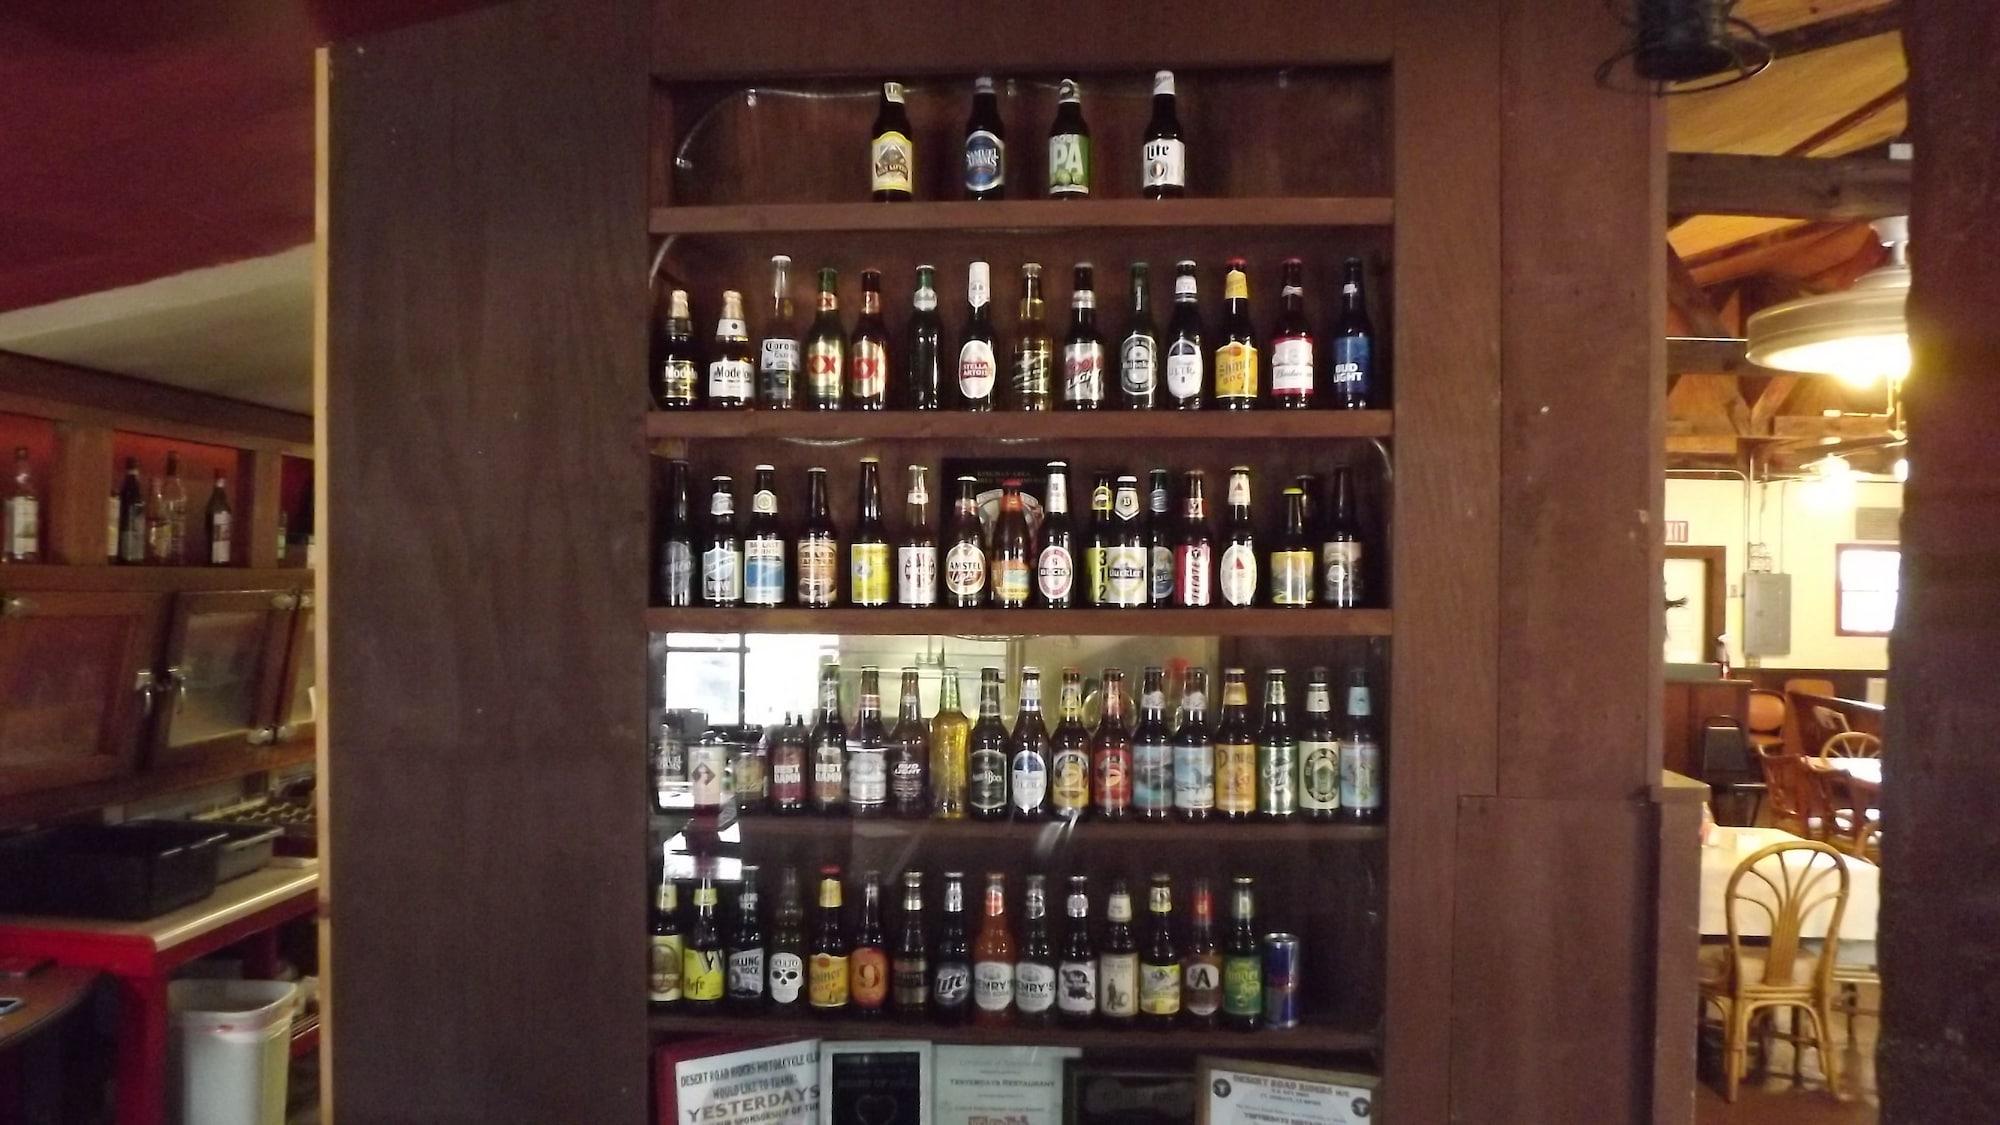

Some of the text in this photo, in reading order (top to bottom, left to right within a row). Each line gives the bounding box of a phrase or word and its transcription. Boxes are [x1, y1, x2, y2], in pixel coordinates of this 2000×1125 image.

[1146, 143, 1170, 161] Lite
[1335, 363, 1358, 373] BUD
[1333, 371, 1363, 384] LIGHT
[949, 562, 982, 570] AMSTEL
[681, 1071, 708, 1087] DESERT
[710, 1067, 730, 1082] ROAD
[731, 1062, 757, 1079] RIDERS
[758, 1054, 804, 1073] MOTORCYCLE
[713, 1085, 740, 1099] WOULD
[741, 1081, 757, 1095] LIKE
[759, 1079, 769, 1091] TO
[1270, 1080, 1298, 1091] ROAD
[688, 1084, 820, 1122] YESTERDAYS
